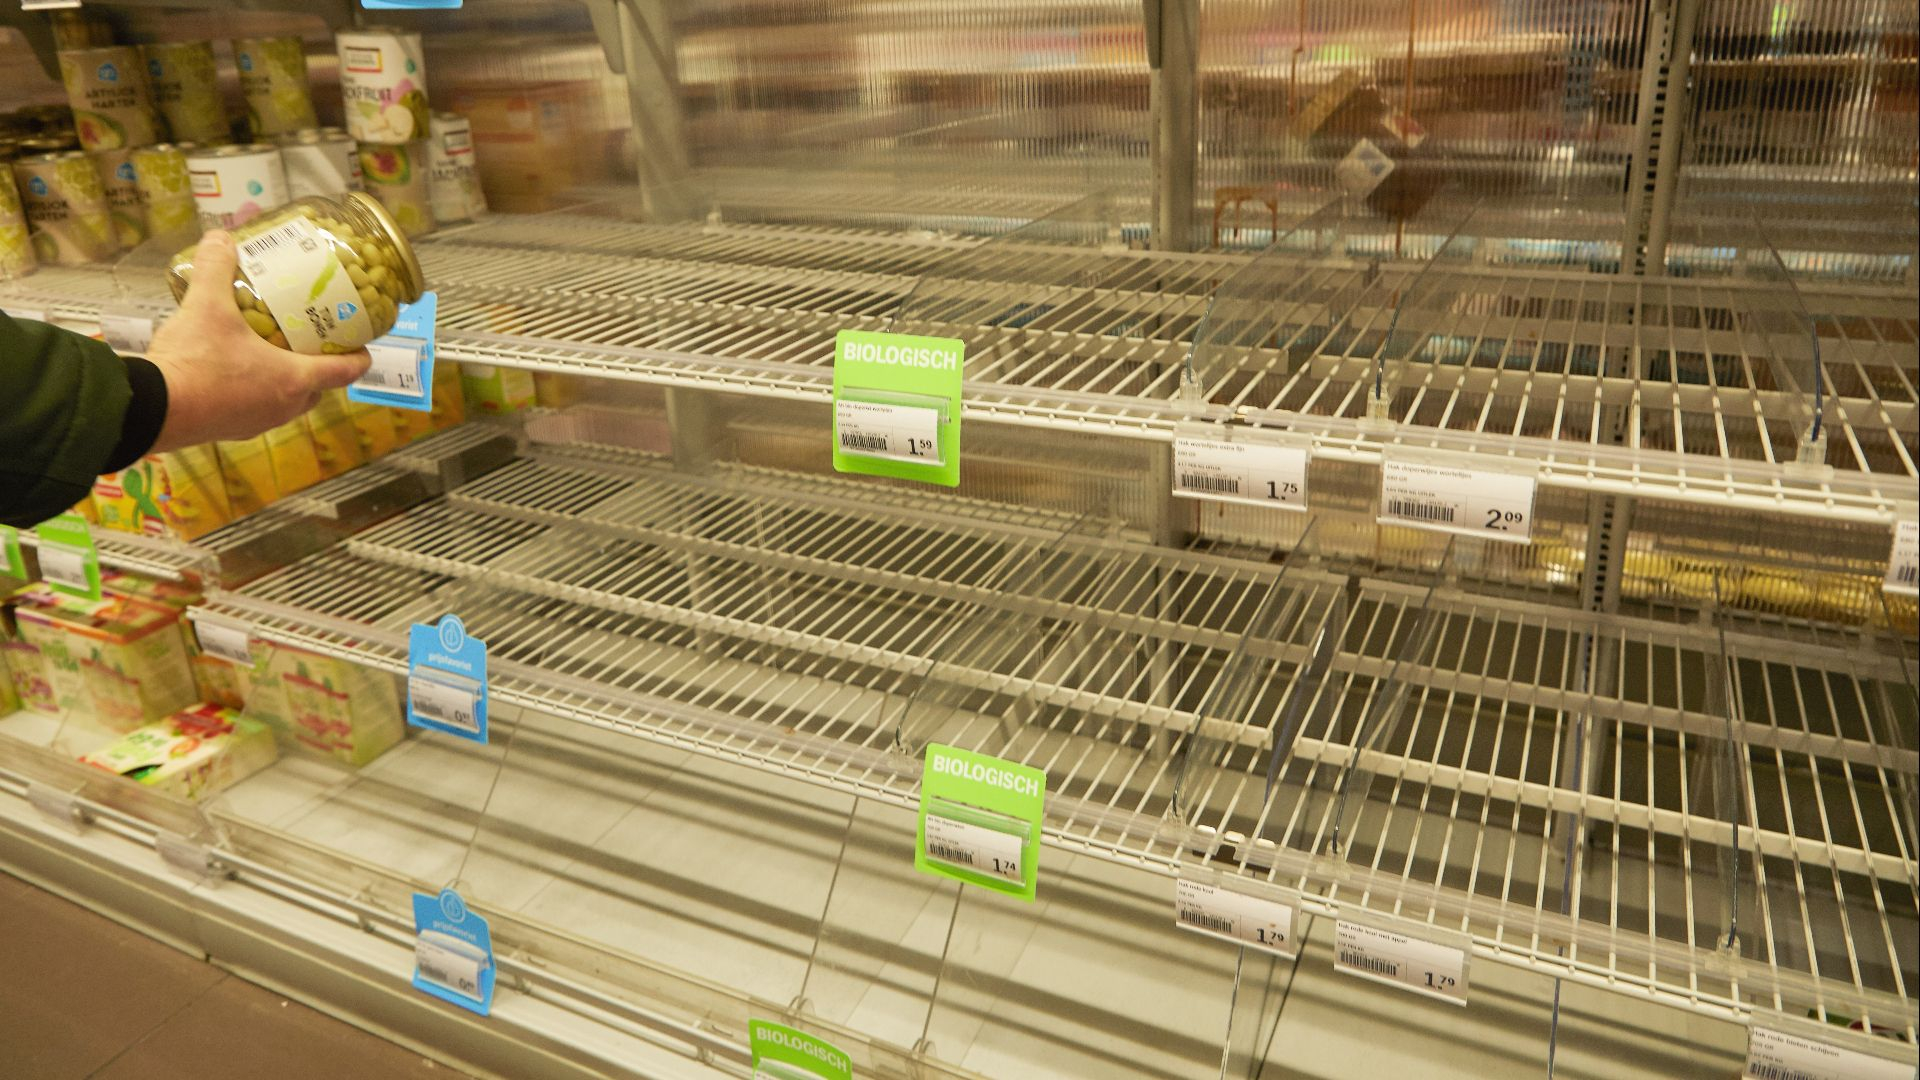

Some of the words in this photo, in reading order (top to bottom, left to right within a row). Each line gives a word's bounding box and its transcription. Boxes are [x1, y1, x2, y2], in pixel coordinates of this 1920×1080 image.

[843, 342, 957, 371] BIOLOGISCH
[907, 437, 933, 456] 1.59
[1266, 480, 1299, 501] 1.75
[1485, 509, 1523, 531] 2.09
[933, 754, 1039, 798] BIOLOGISCH
[993, 857, 1016, 876] 1.74
[1256, 927, 1285, 946] 1.79
[1424, 970, 1456, 990] 1.79
[756, 1026, 848, 1073] BIOLOGISCH
[1767, 1034, 1785, 1042] rode
[1786, 1038, 1808, 1049] bieten
[1810, 1046, 1840, 1058] schijven
